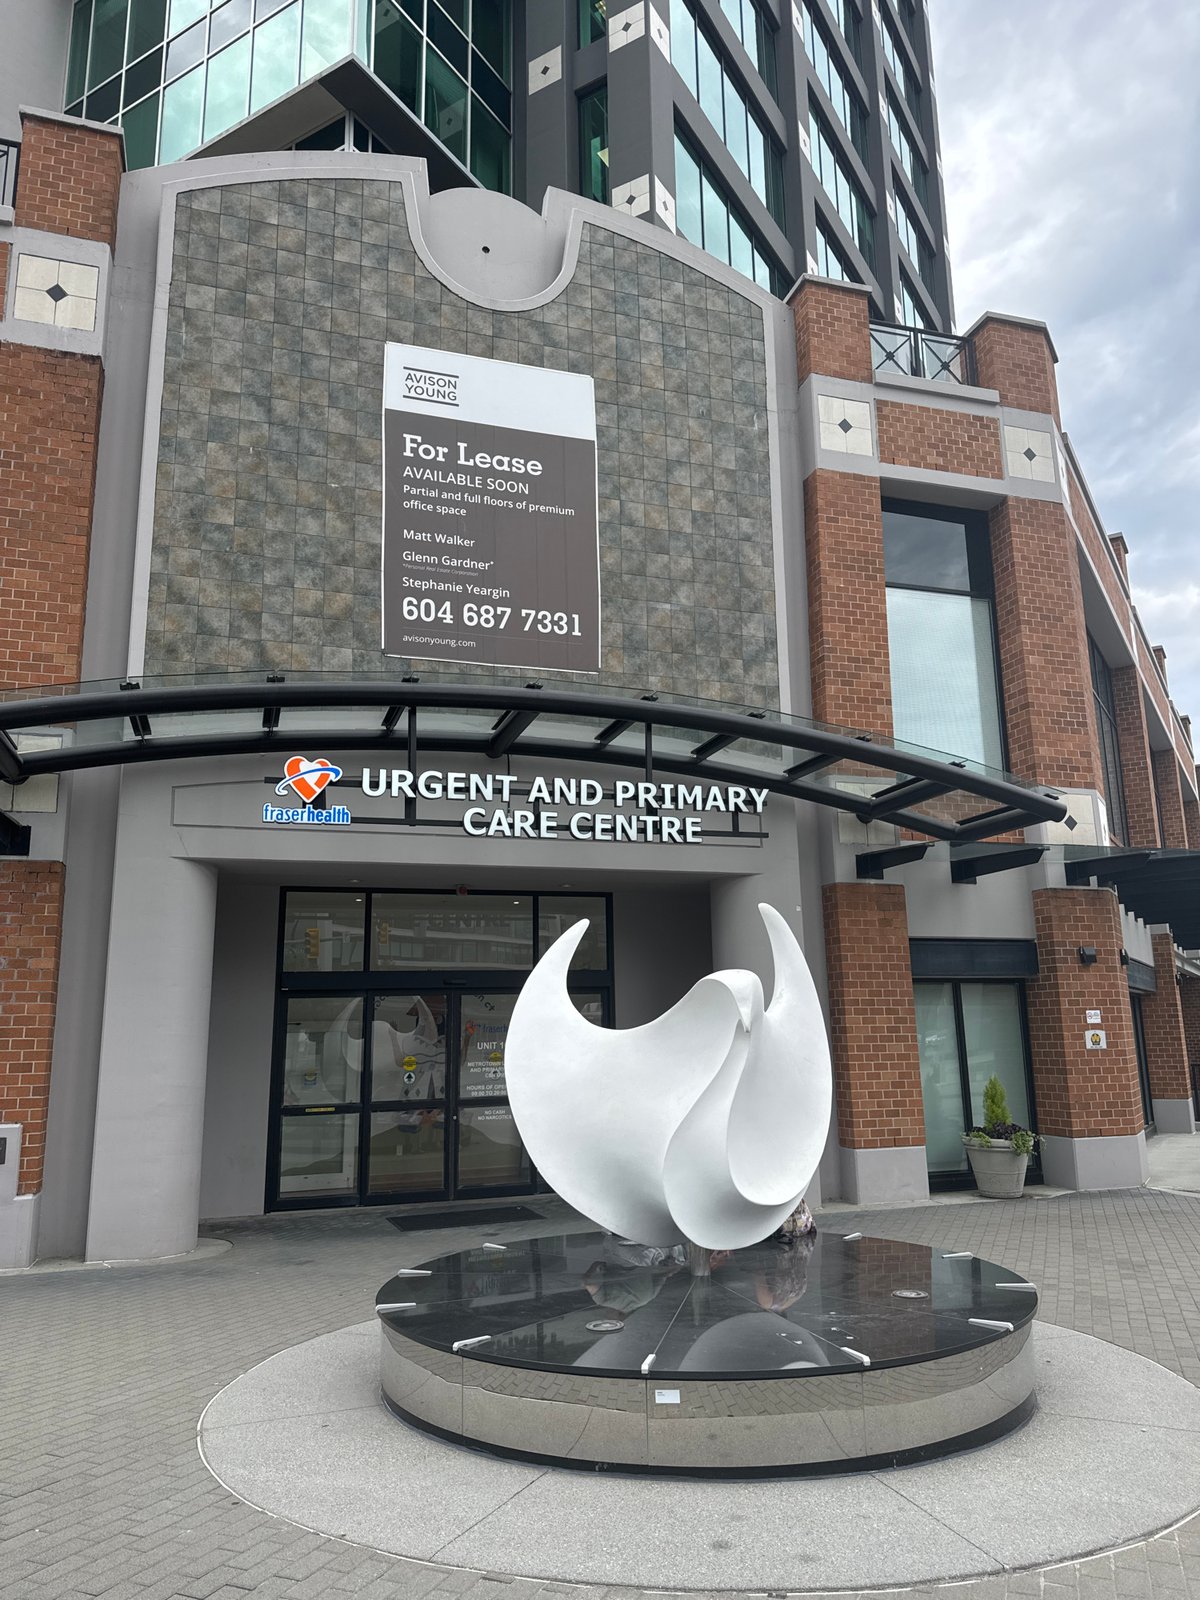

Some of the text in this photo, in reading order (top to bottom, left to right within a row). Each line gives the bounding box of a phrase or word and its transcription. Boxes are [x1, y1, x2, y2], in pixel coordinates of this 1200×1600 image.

[405, 373, 457, 390] AVISON
[405, 384, 457, 401] YOUNG
[403, 433, 543, 476] For Lease
[403, 466, 529, 495] AVAILABLE SOON
[403, 484, 575, 516] Partial and full floors of premium
[403, 500, 467, 516] office space
[403, 529, 476, 547] Matt Walker
[402, 551, 438, 564] Glenn
[402, 576, 510, 600] Stephanie Yeargin
[402, 596, 582, 636] 604 687 7331
[402, 634, 477, 648] avisonyoung.com
[361, 767, 770, 813] URGENT AND PRIMARY
[263, 803, 350, 824] fraserhealth
[463, 807, 703, 844] CARE CENTRE
[477, 1042, 498, 1050] UNIT
